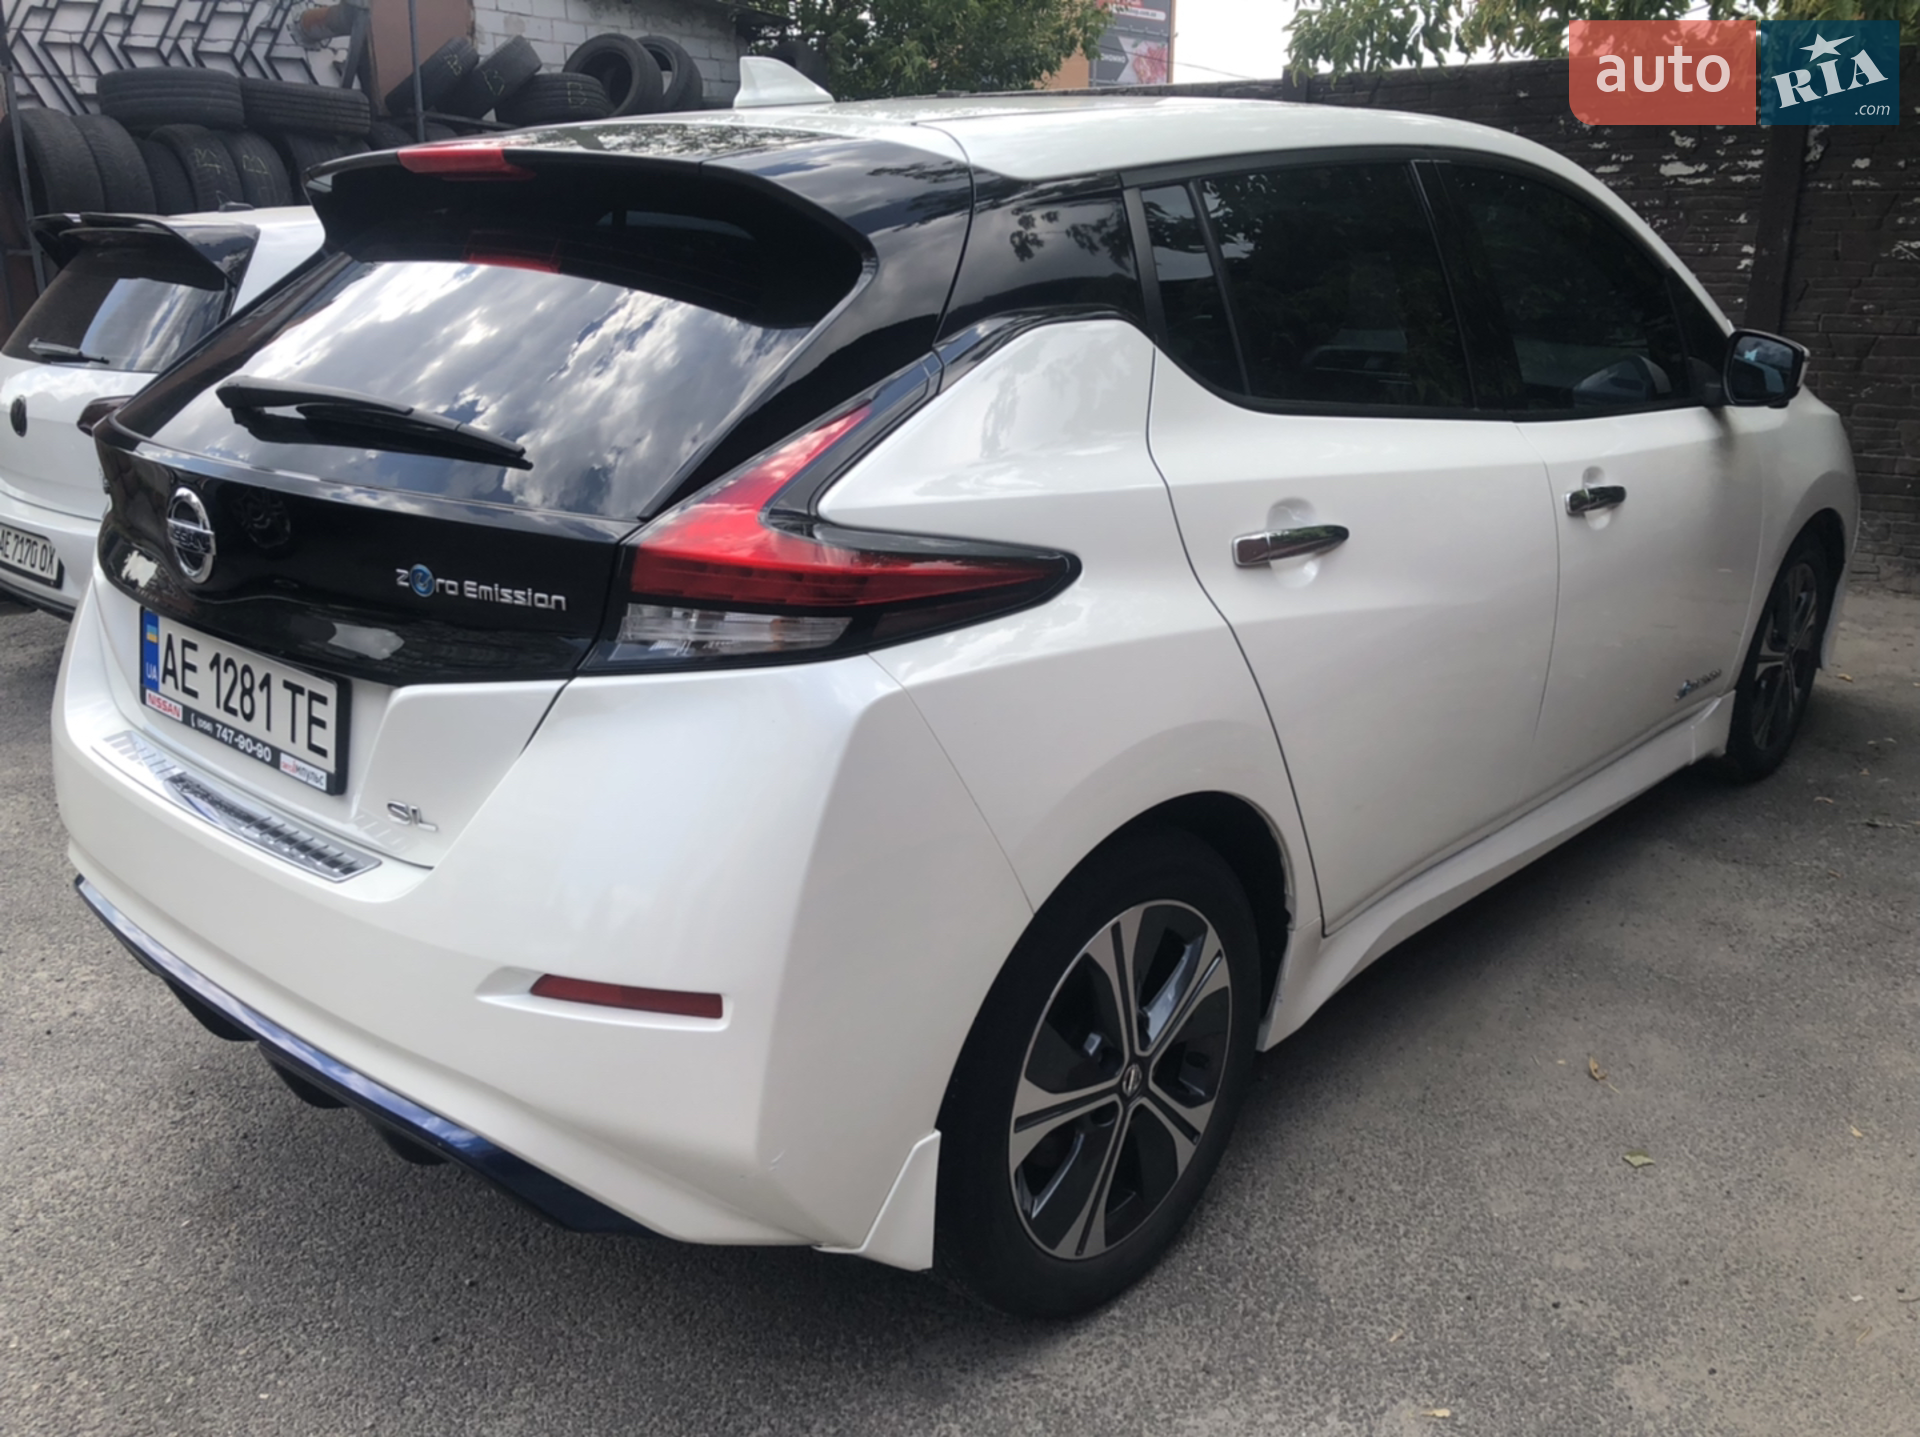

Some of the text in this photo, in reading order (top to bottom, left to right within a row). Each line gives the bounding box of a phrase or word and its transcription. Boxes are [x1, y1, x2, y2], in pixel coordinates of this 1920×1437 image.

[12, 534, 38, 569] 7170
[39, 543, 56, 575] OX
[463, 580, 567, 611] Emission
[146, 661, 158, 682] UA
[148, 692, 181, 718] NISSAN
[161, 632, 328, 758] AE 1281 TE
[215, 723, 272, 762] 747-90-90
[387, 801, 439, 832] SL
